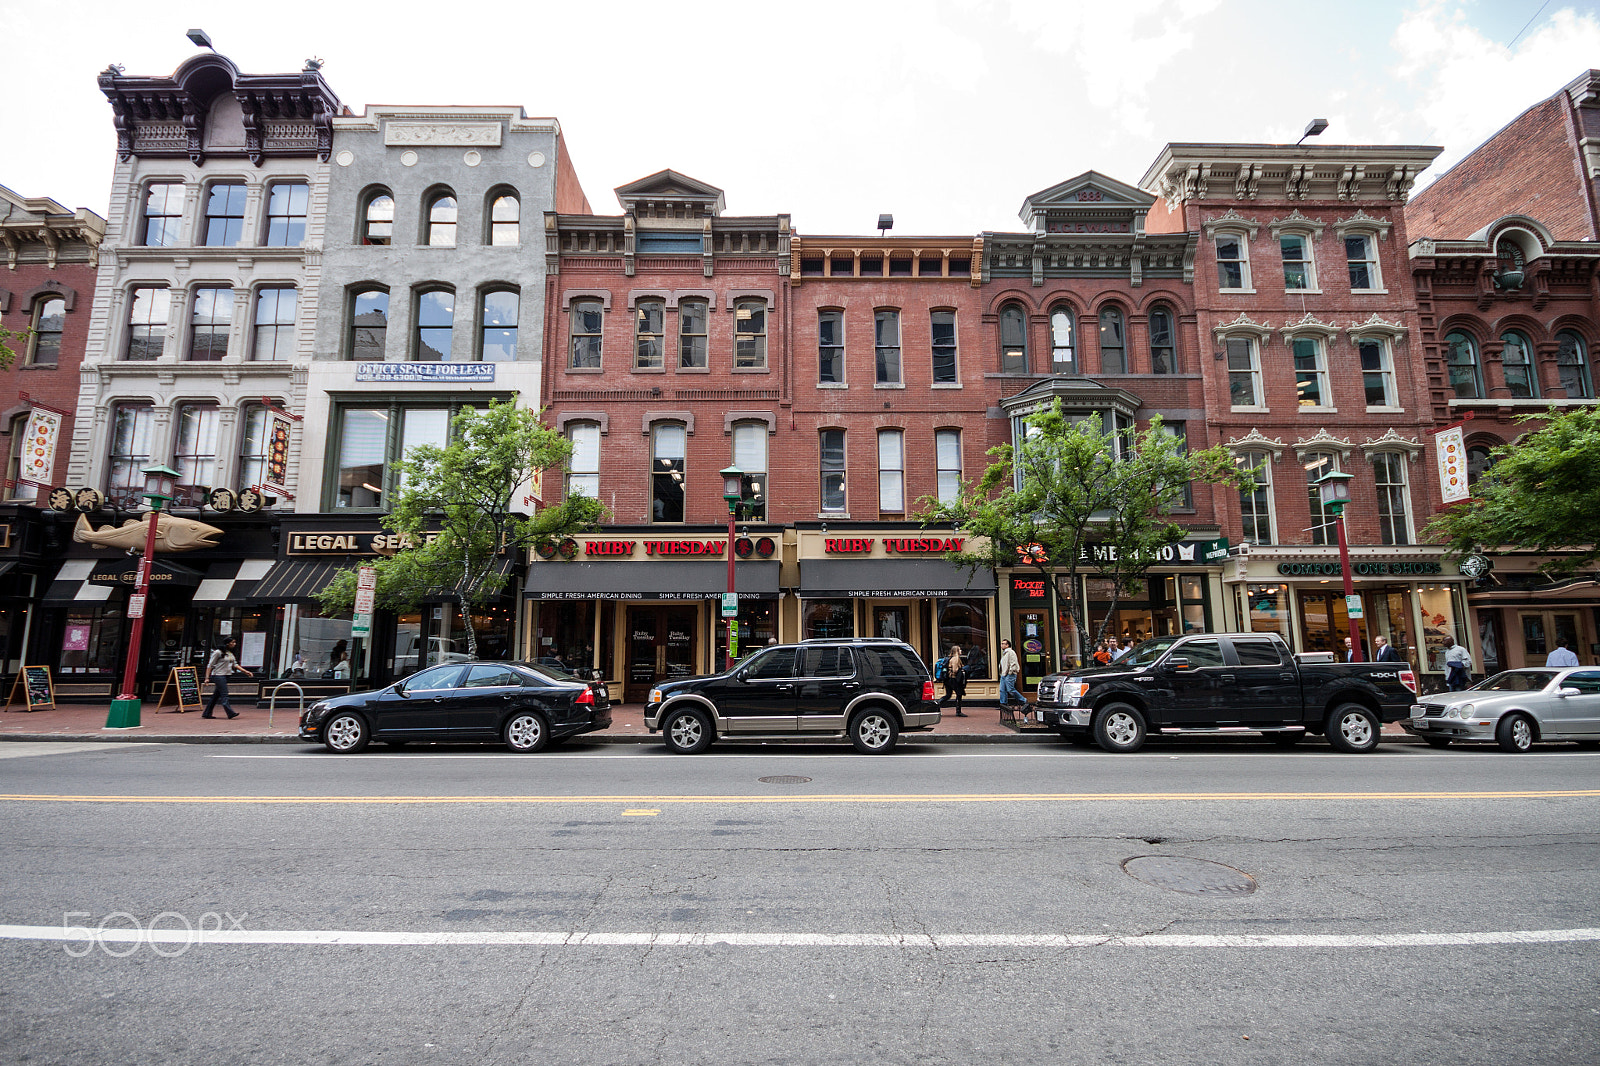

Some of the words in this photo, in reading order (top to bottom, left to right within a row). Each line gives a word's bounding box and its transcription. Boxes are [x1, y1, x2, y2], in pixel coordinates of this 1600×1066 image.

[1077, 192, 1102, 202] 1888
[358, 364, 396, 374] OFFICE
[399, 364, 434, 375] SPACE
[436, 364, 459, 375] FOR
[460, 364, 494, 375] LEASE
[293, 535, 359, 550] LEGAL
[371, 534, 414, 549] SEA
[825, 538, 875, 553] RUBY
[882, 538, 965, 553] TUESDAY
[585, 541, 637, 556] RUBY
[643, 541, 727, 556] TUESDAY
[1278, 562, 1352, 575] COMFOR
[1355, 562, 1389, 575] ONE
[1390, 561, 1442, 575] SHOES
[150, 573, 173, 581] OODS
[1014, 579, 1045, 590] ROCKET
[1029, 589, 1045, 597] BAR
